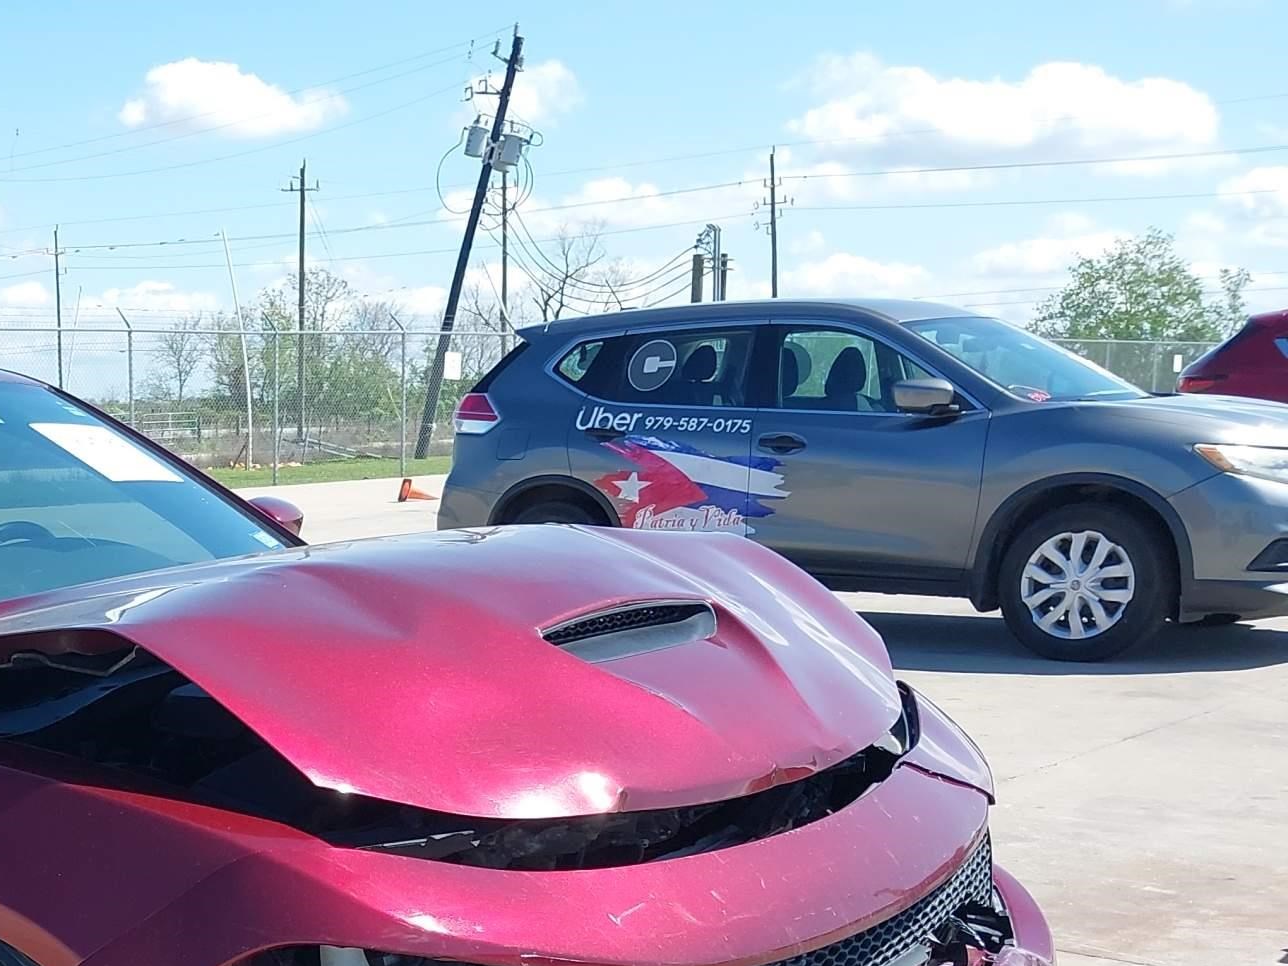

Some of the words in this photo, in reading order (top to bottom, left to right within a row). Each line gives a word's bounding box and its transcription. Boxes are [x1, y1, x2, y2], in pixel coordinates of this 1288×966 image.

[575, 405, 644, 432] Uber
[645, 416, 752, 434] 979-587-0175
[633, 504, 686, 529] Patria
[689, 517, 699, 529] y
[701, 505, 742, 528] Vida
